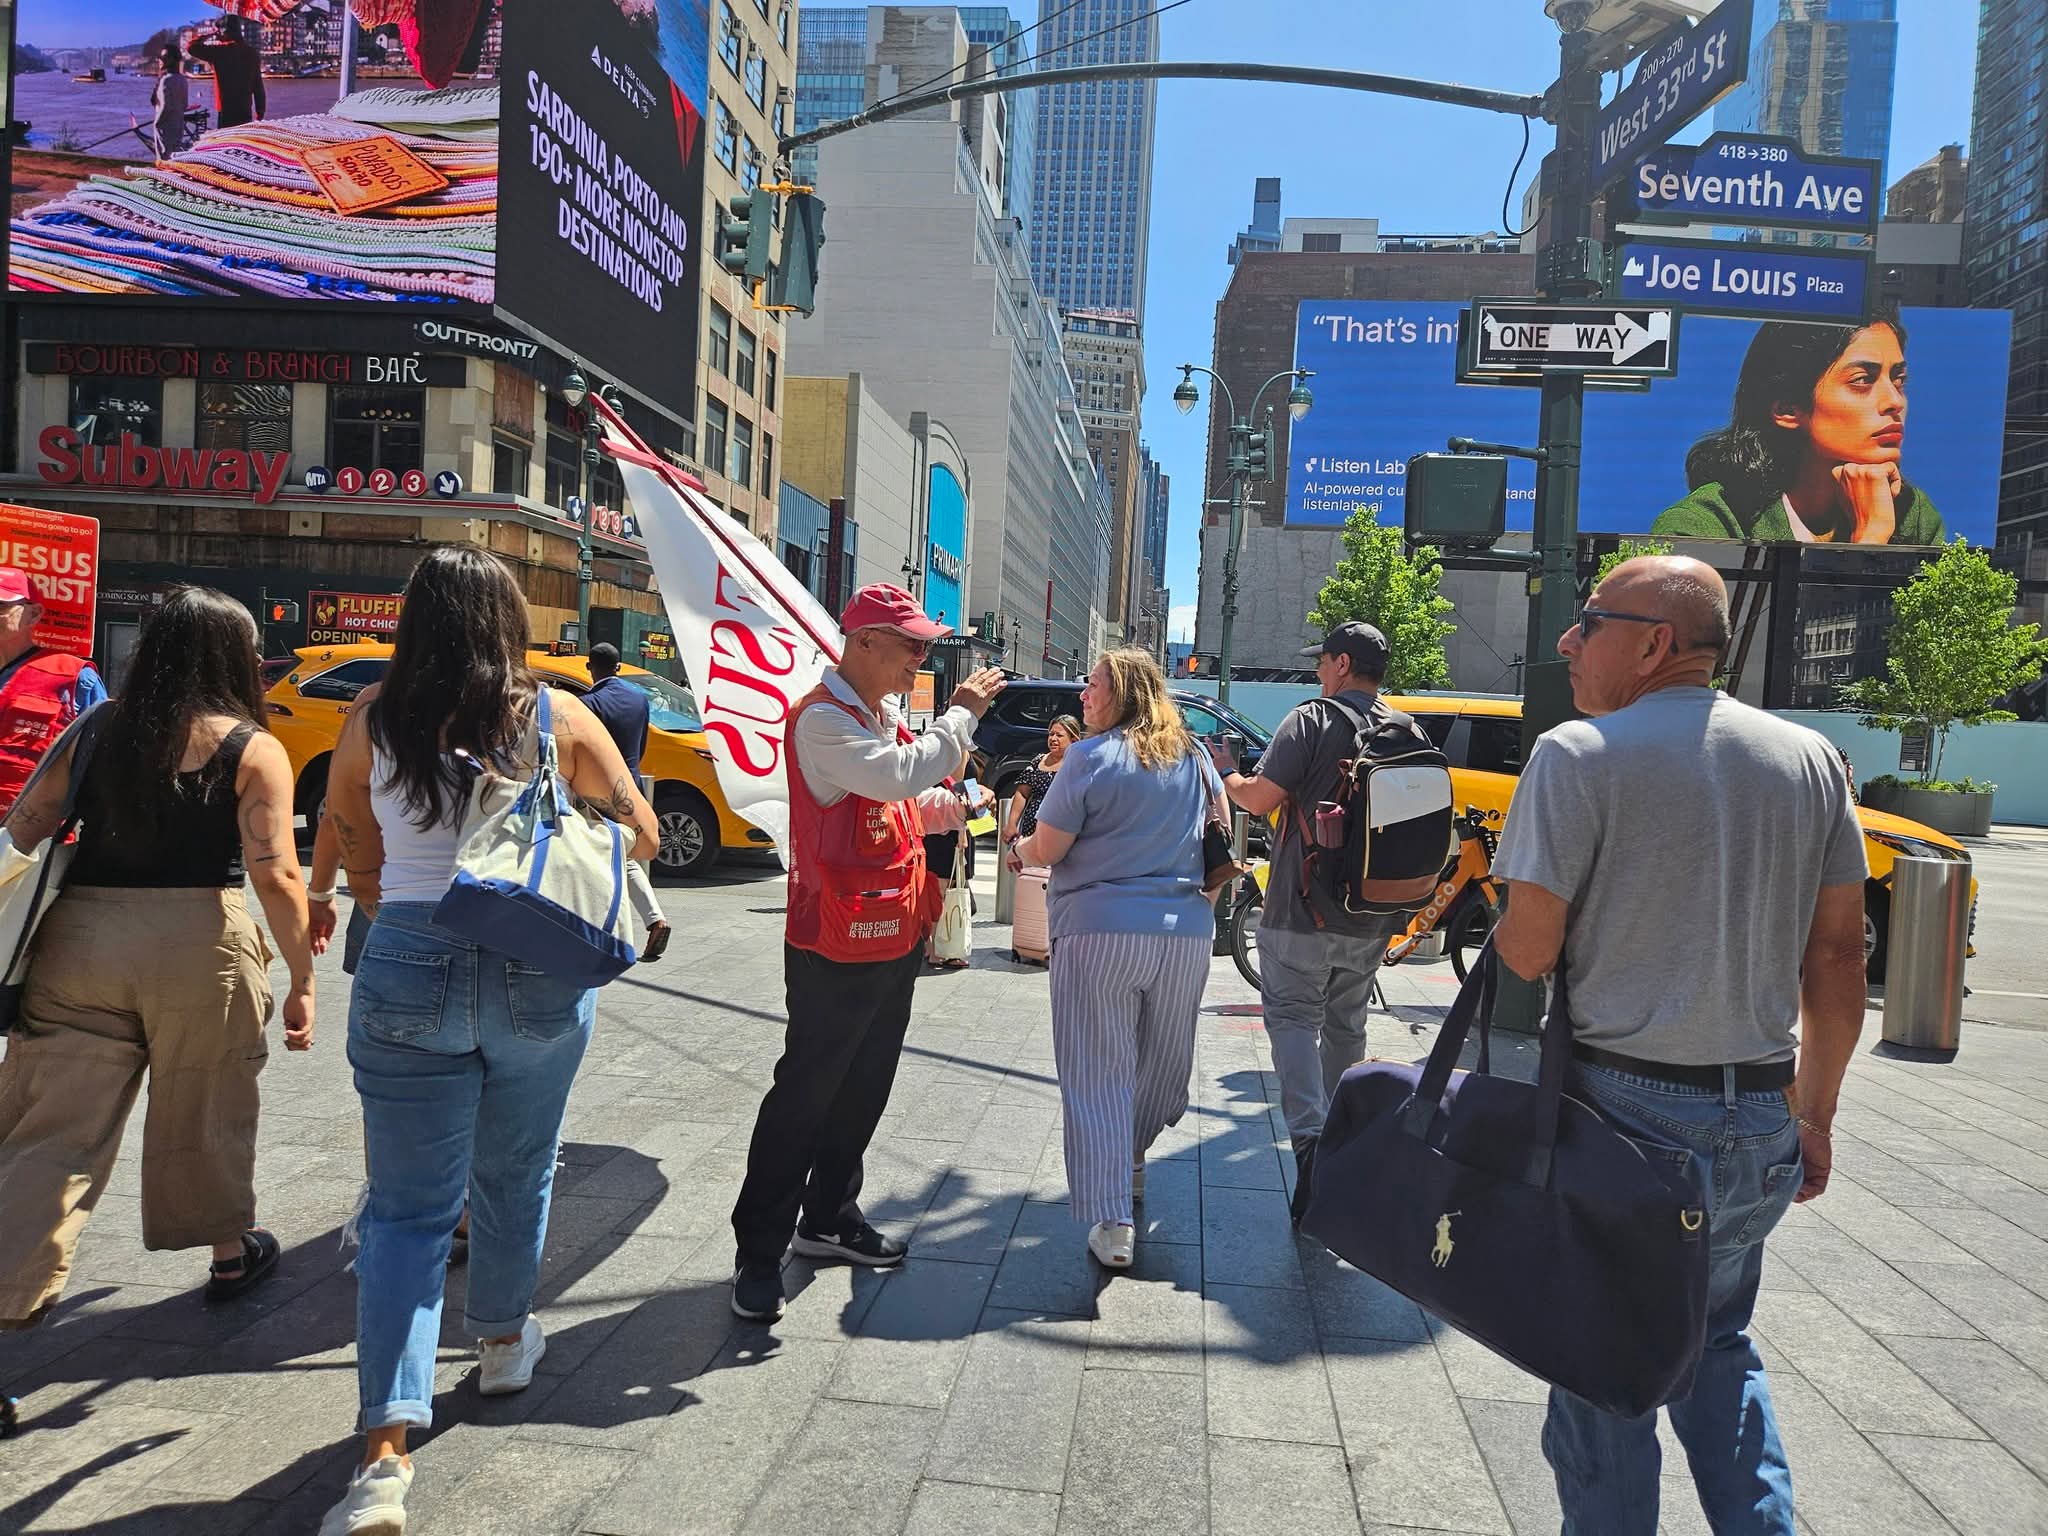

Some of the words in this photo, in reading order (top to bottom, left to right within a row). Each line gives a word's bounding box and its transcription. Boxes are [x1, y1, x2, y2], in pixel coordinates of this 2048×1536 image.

[604, 56, 639, 109] DELTA
[1600, 95, 1651, 165] West
[1654, 48, 1697, 122] 33rd
[1701, 28, 1728, 83] St
[527, 70, 612, 188] SARDINIA,
[614, 154, 660, 226] PORTO
[660, 203, 688, 251] AND
[1718, 144, 1746, 160] 418
[1760, 147, 1788, 162] 380
[530, 124, 573, 185] 190+
[575, 164, 622, 237] MORE
[623, 207, 684, 287] NONSTOP
[1638, 163, 1784, 208] Seventh
[1795, 175, 1863, 214] Ave
[558, 197, 663, 313] DESTINATIONS
[1646, 254, 1701, 291] Joe
[1806, 276, 1844, 294] Plaza
[1500, 326, 1550, 348] ONE
[1576, 327, 1632, 350] WAY
[55, 345, 199, 377] BOURBON
[211, 352, 233, 376] &
[246, 350, 351, 382] BRANCH
[366, 356, 428, 384] BAR
[37, 425, 291, 505] Subway
[1321, 457, 1370, 474] Listen
[1375, 459, 1406, 475] Lab
[1303, 481, 1384, 497] AI-powered
[1303, 498, 1383, 512] listenlabsai
[70, 525, 79, 534] to
[79, 528, 94, 536] go?
[0, 541, 92, 577] JESUS
[932, 542, 963, 580] PRIMARK
[26, 571, 92, 604] RIST
[345, 617, 367, 628] HOT
[1419, 881, 1456, 930] JOCO
[849, 928, 857, 938] IS
[857, 930, 872, 939] THE
[873, 927, 900, 938] SAVIOR
[850, 921, 874, 931] JESUS
[874, 918, 900, 930] CHRIST
